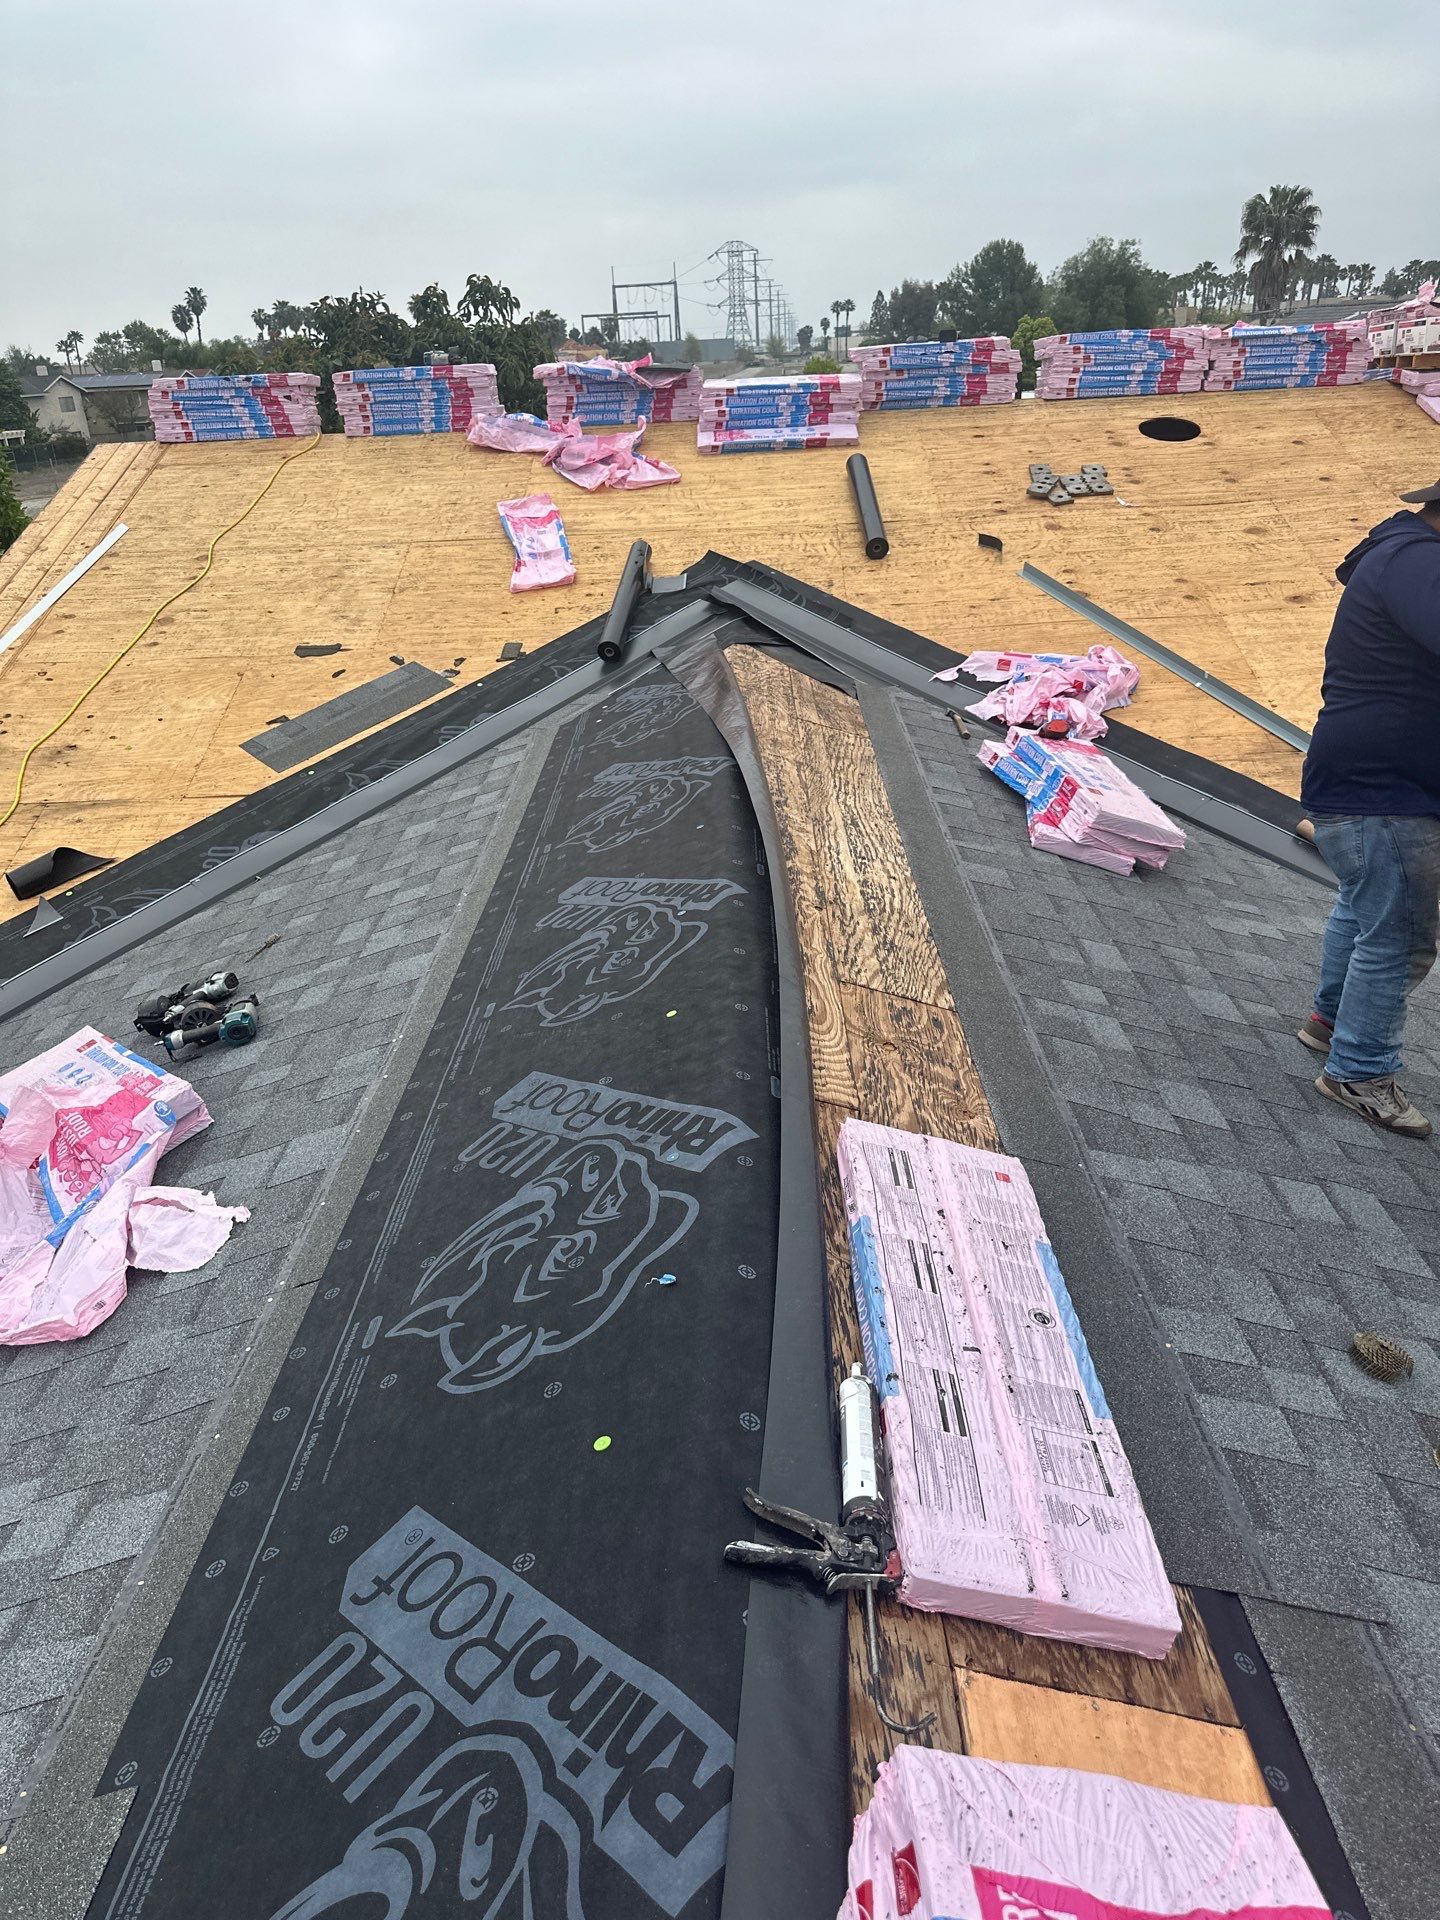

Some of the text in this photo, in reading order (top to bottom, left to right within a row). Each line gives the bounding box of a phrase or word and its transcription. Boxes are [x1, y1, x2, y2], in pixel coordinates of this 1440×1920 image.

[1251, 348, 1281, 356] DURATION
[1281, 347, 1297, 355] COOL
[1276, 356, 1291, 364] COOL
[354, 371, 383, 379] DURATION
[383, 370, 398, 378] COOL
[578, 393, 607, 402] DURATION
[607, 392, 622, 401] COOL
[728, 397, 758, 405] DURATION
[759, 396, 773, 404] COOL
[577, 403, 605, 411] DURATION
[731, 406, 760, 414] DURATION
[761, 405, 777, 414] COOL
[603, 412, 618, 420] COOL
[374, 423, 403, 432] DURATION
[403, 422, 419, 430] COOL
[727, 419, 757, 427] DURATION
[757, 418, 772, 426] COOL
[64, 1111, 93, 1138] ROOF
[60, 1124, 79, 1147] JUST
[458, 1122, 560, 1178] U20
[270, 1632, 435, 1803] U20
